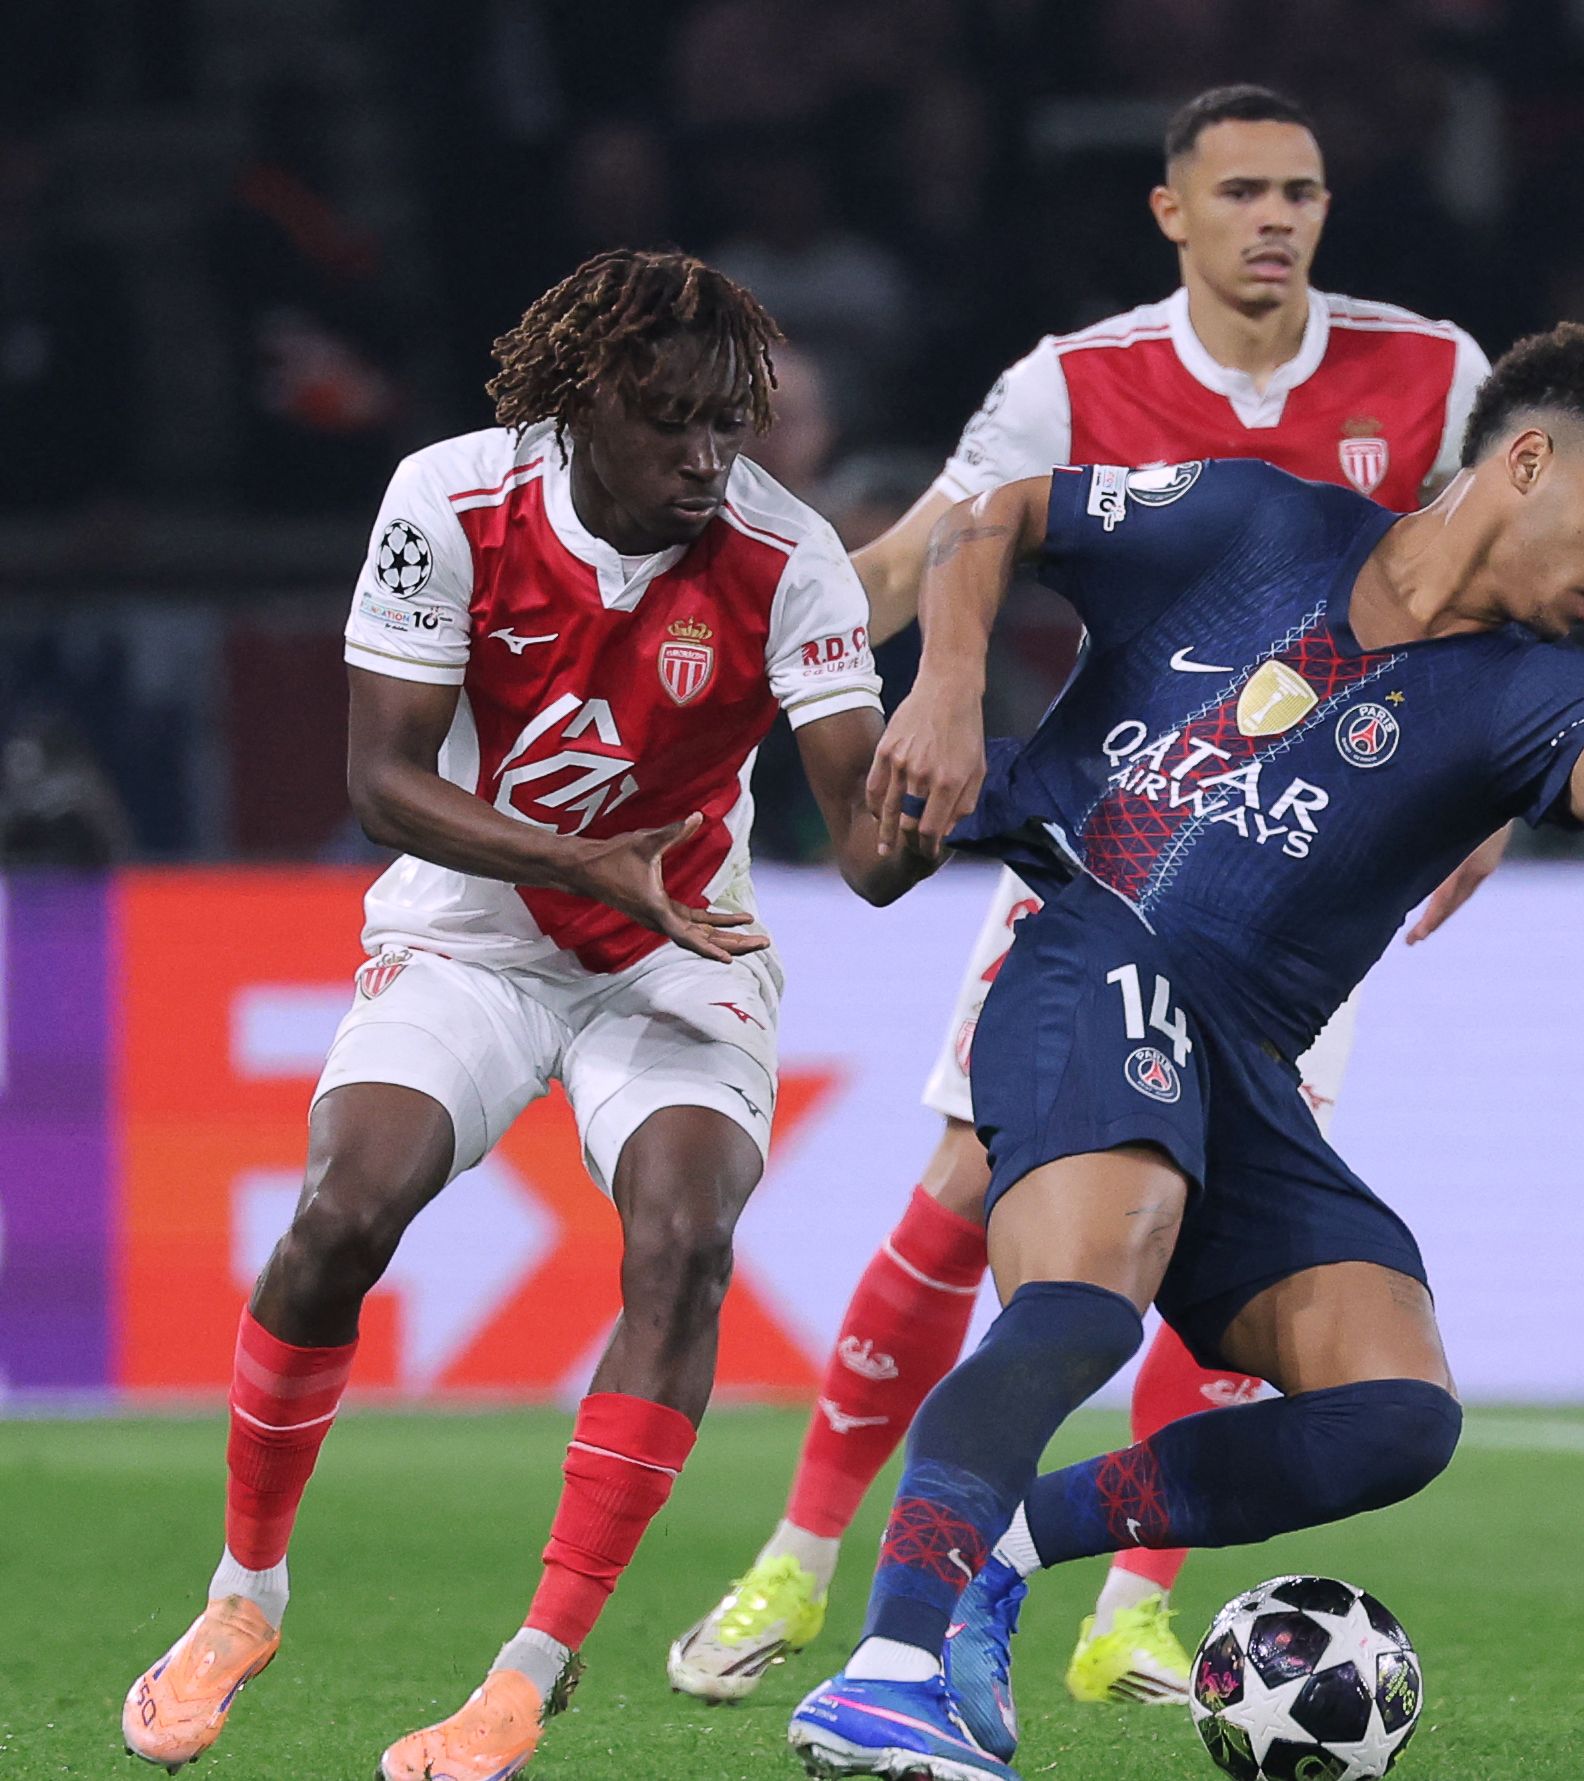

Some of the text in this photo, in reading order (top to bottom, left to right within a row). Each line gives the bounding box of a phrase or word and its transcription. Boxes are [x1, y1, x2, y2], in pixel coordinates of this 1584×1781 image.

[1359, 706, 1396, 733] PARIS
[1103, 720, 1329, 833] QATAR
[1108, 765, 1313, 858] AIRWAYS
[1106, 963, 1192, 1068] 14
